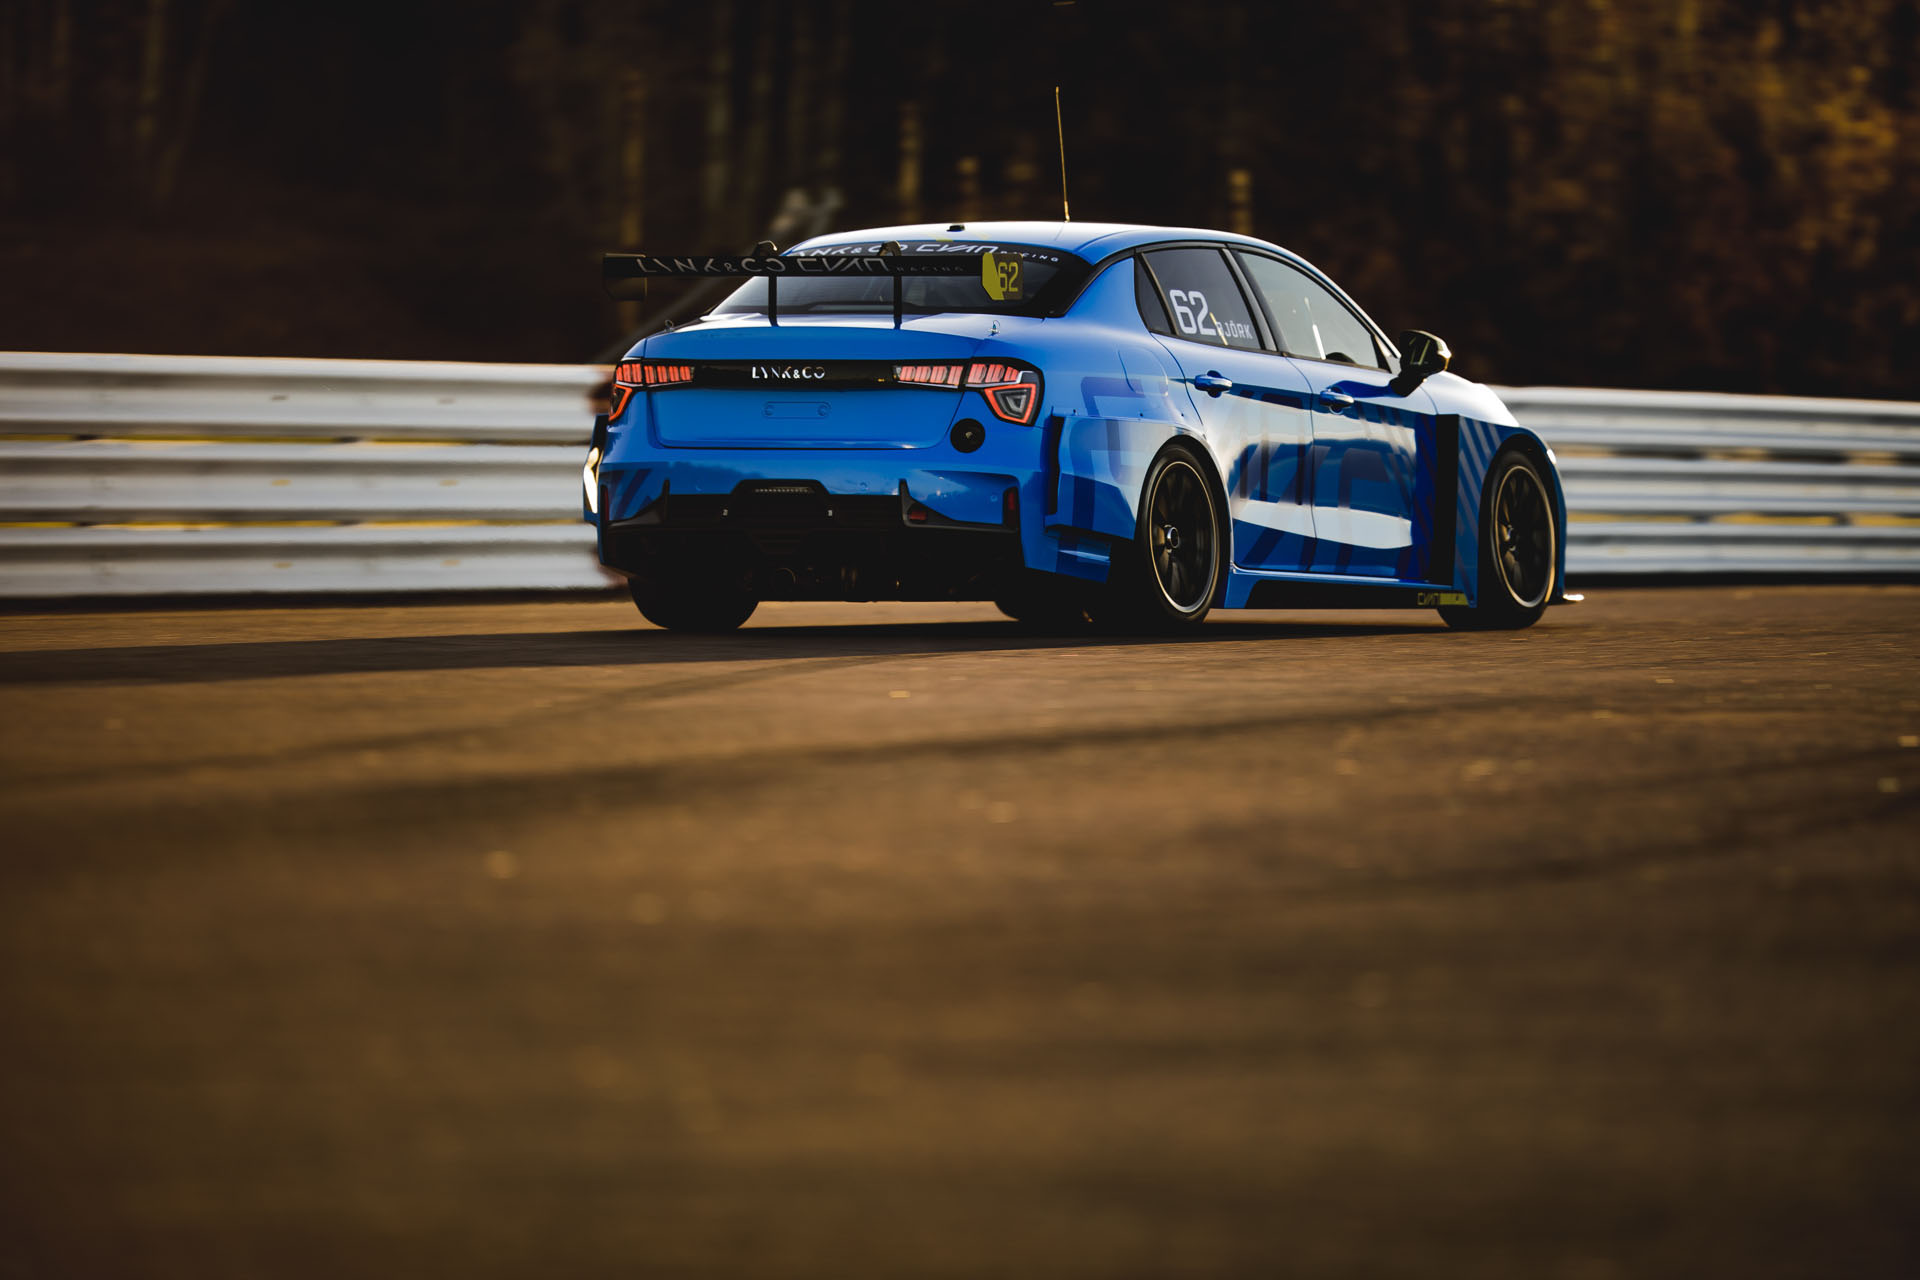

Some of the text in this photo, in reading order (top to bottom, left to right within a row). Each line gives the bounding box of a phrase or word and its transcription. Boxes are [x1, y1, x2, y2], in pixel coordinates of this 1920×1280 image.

[1000, 251, 1059, 262] RCING
[998, 261, 1019, 292] 62
[1169, 289, 1253, 340] 62 BJÖRK
